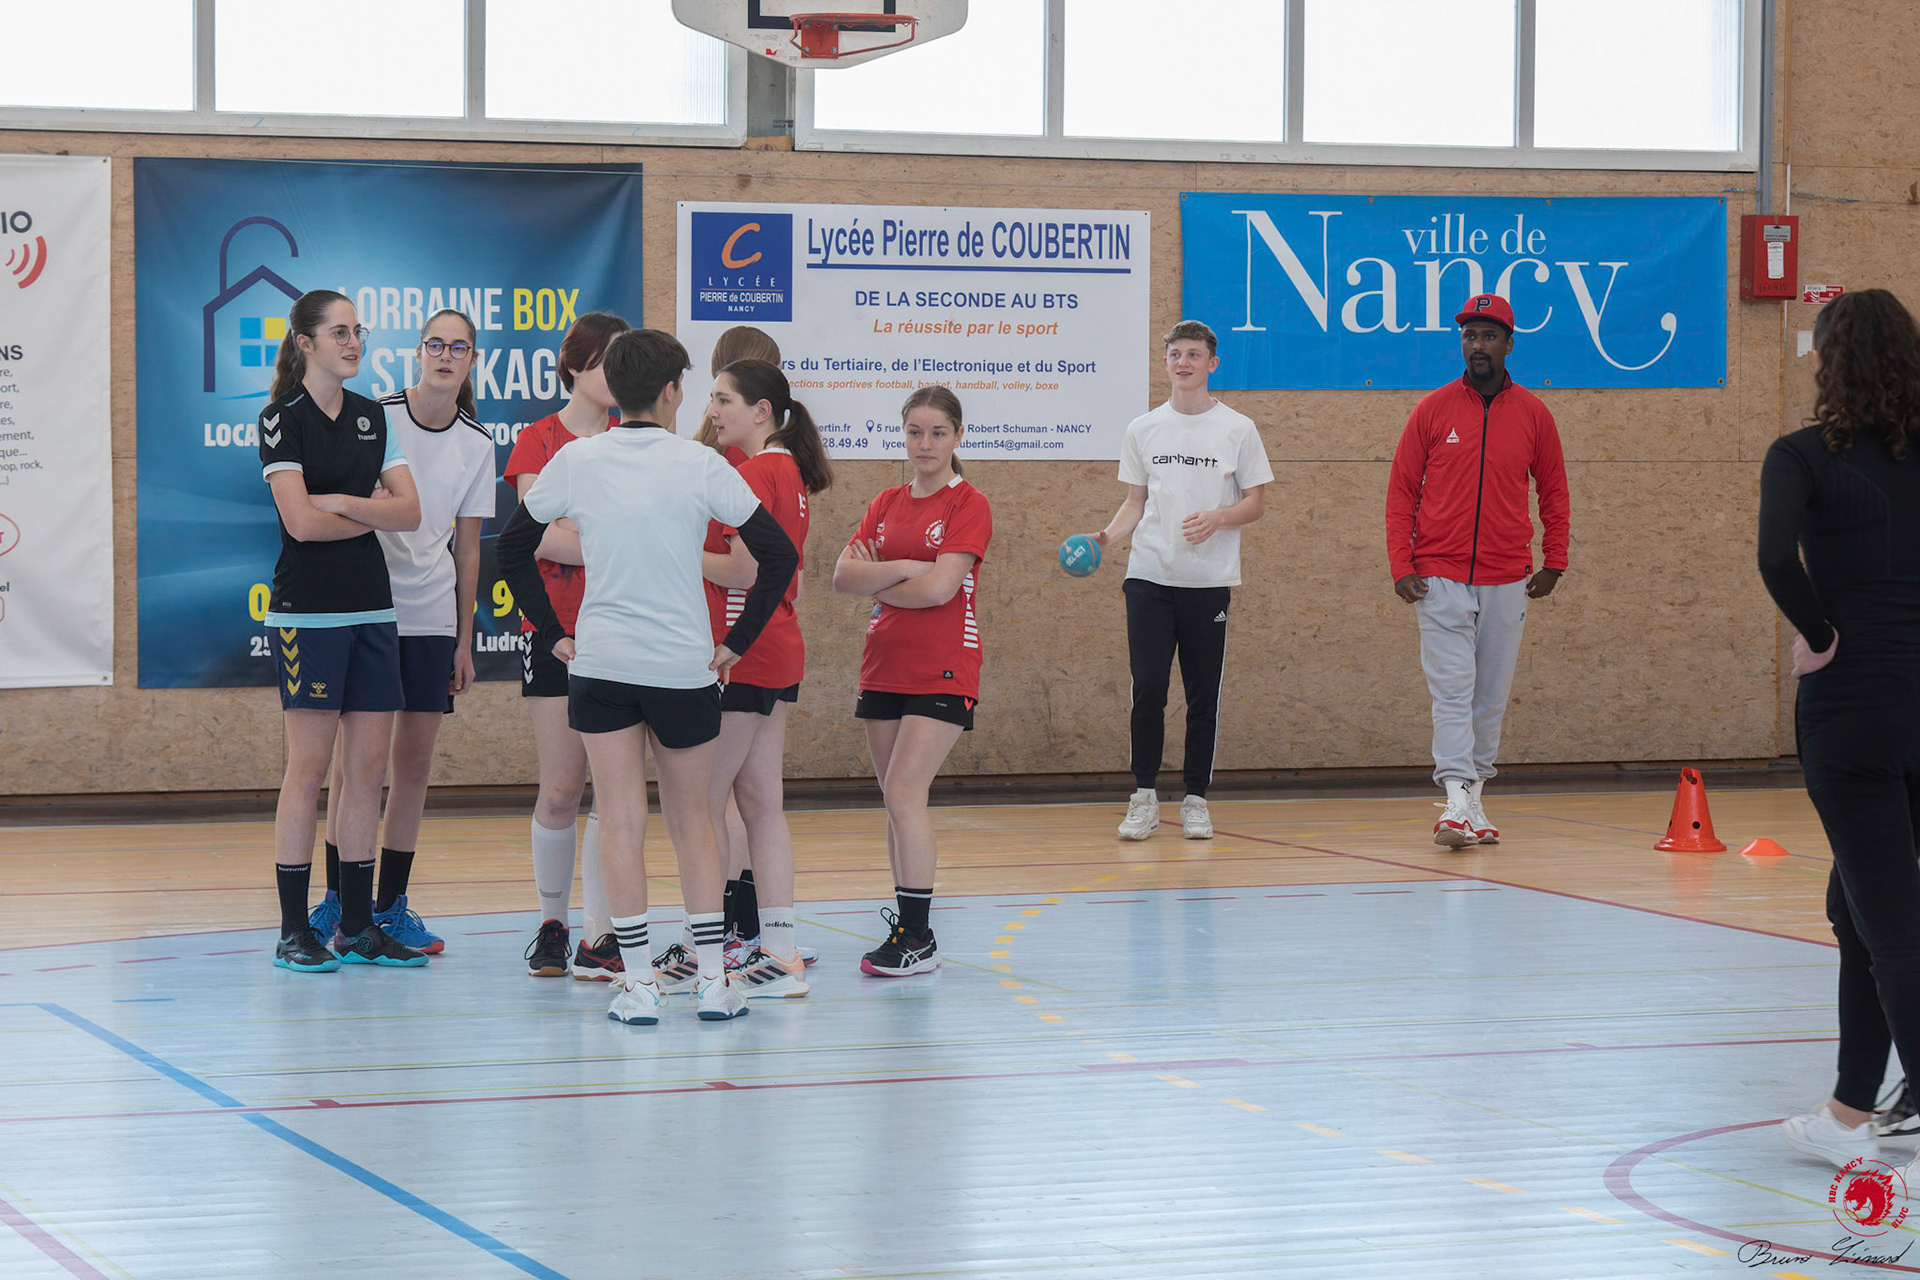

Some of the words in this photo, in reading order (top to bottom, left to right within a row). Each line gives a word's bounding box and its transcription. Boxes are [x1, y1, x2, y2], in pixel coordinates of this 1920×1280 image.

[808, 218, 875, 264] Lycée
[883, 219, 949, 257] Pierre
[957, 221, 984, 258] de
[991, 221, 1130, 260] COUBERTIN
[1402, 212, 1489, 255] ville
[1501, 213, 1547, 255] de
[700, 291, 728, 303] PIERRE
[729, 292, 738, 303] de
[740, 292, 784, 304] COUBERTIN
[1231, 209, 1677, 370] Nancy
[855, 291, 880, 306] DE
[886, 291, 911, 307] LA
[915, 292, 1006, 308] SECONDE
[1011, 293, 1037, 308] AU
[1043, 294, 1079, 309] BTS
[1474, 297, 1491, 312] P
[338, 286, 503, 331] ORRAINE
[513, 288, 580, 331] BOX
[727, 305, 755, 313] NANCY
[873, 319, 892, 333] La
[898, 319, 962, 335] réussite
[966, 324, 993, 338] par
[998, 321, 1012, 335] le
[1016, 321, 1059, 338] sport
[800, 357, 819, 371] du
[823, 358, 887, 374] Tertiaire,
[891, 358, 909, 372] de
[1017, 361, 1031, 373] et
[1035, 360, 1053, 373] du
[1057, 360, 1096, 376] Sport
[827, 380, 872, 391] sportives
[875, 380, 915, 390] football,
[955, 381, 1000, 391] handball,
[1002, 382, 1033, 392] volley,
[1035, 382, 1059, 391] boxe
[876, 424, 883, 433] 5
[967, 424, 1000, 434] Robert
[1002, 424, 1048, 434] Schuman
[1056, 424, 1092, 434] NANCY
[20, 460, 43, 470] rock,
[1152, 454, 1218, 467] carhartt
